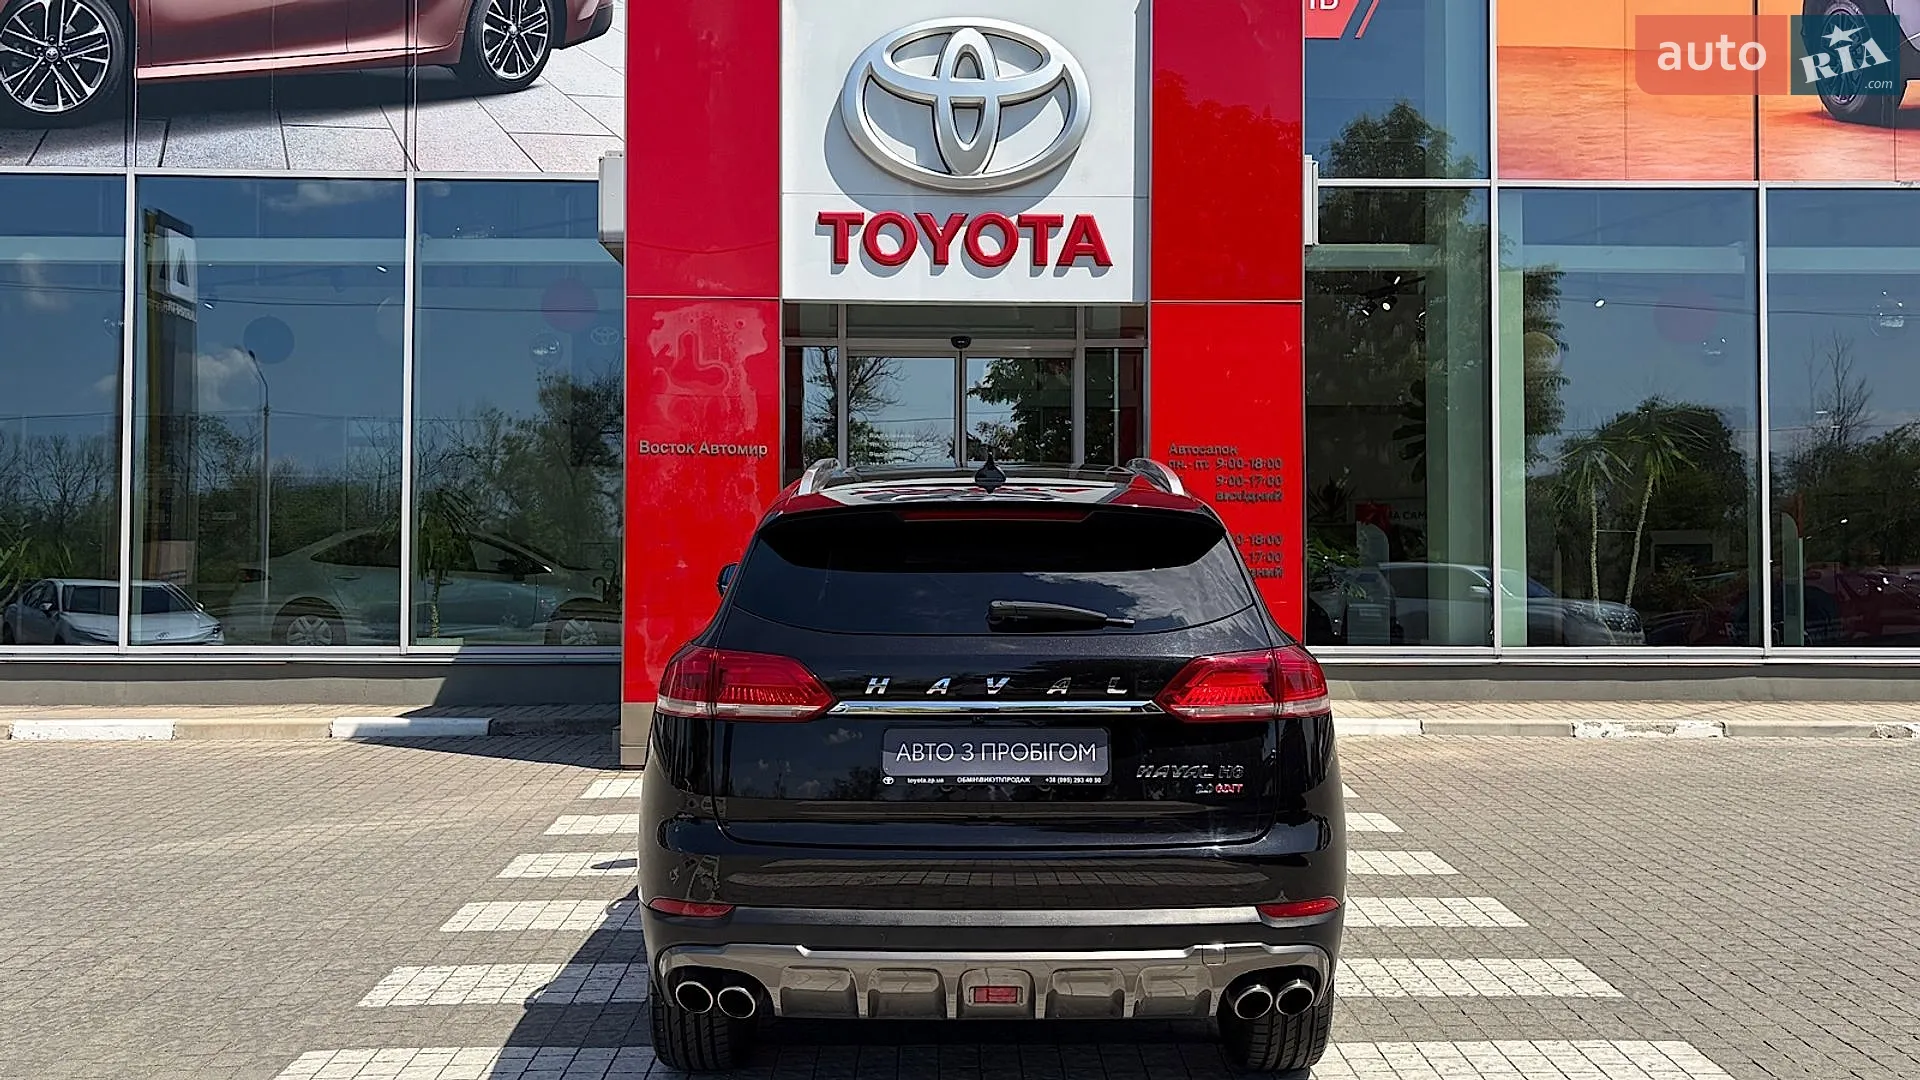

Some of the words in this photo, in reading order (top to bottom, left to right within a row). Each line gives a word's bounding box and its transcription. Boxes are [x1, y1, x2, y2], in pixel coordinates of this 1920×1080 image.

[818, 211, 1113, 268] TOYOTA
[639, 440, 695, 454] Восток
[698, 440, 768, 458] Автомир
[1168, 442, 1238, 456] Автосалон
[1216, 457, 1283, 470] 9:00-18:00
[1234, 534, 1282, 546] 0-18:00
[864, 676, 1128, 695] HAVAL
[896, 742, 954, 762] АВТО
[981, 742, 1097, 762] ПРОБІГОМ
[1136, 765, 1214, 779] HAVAL
